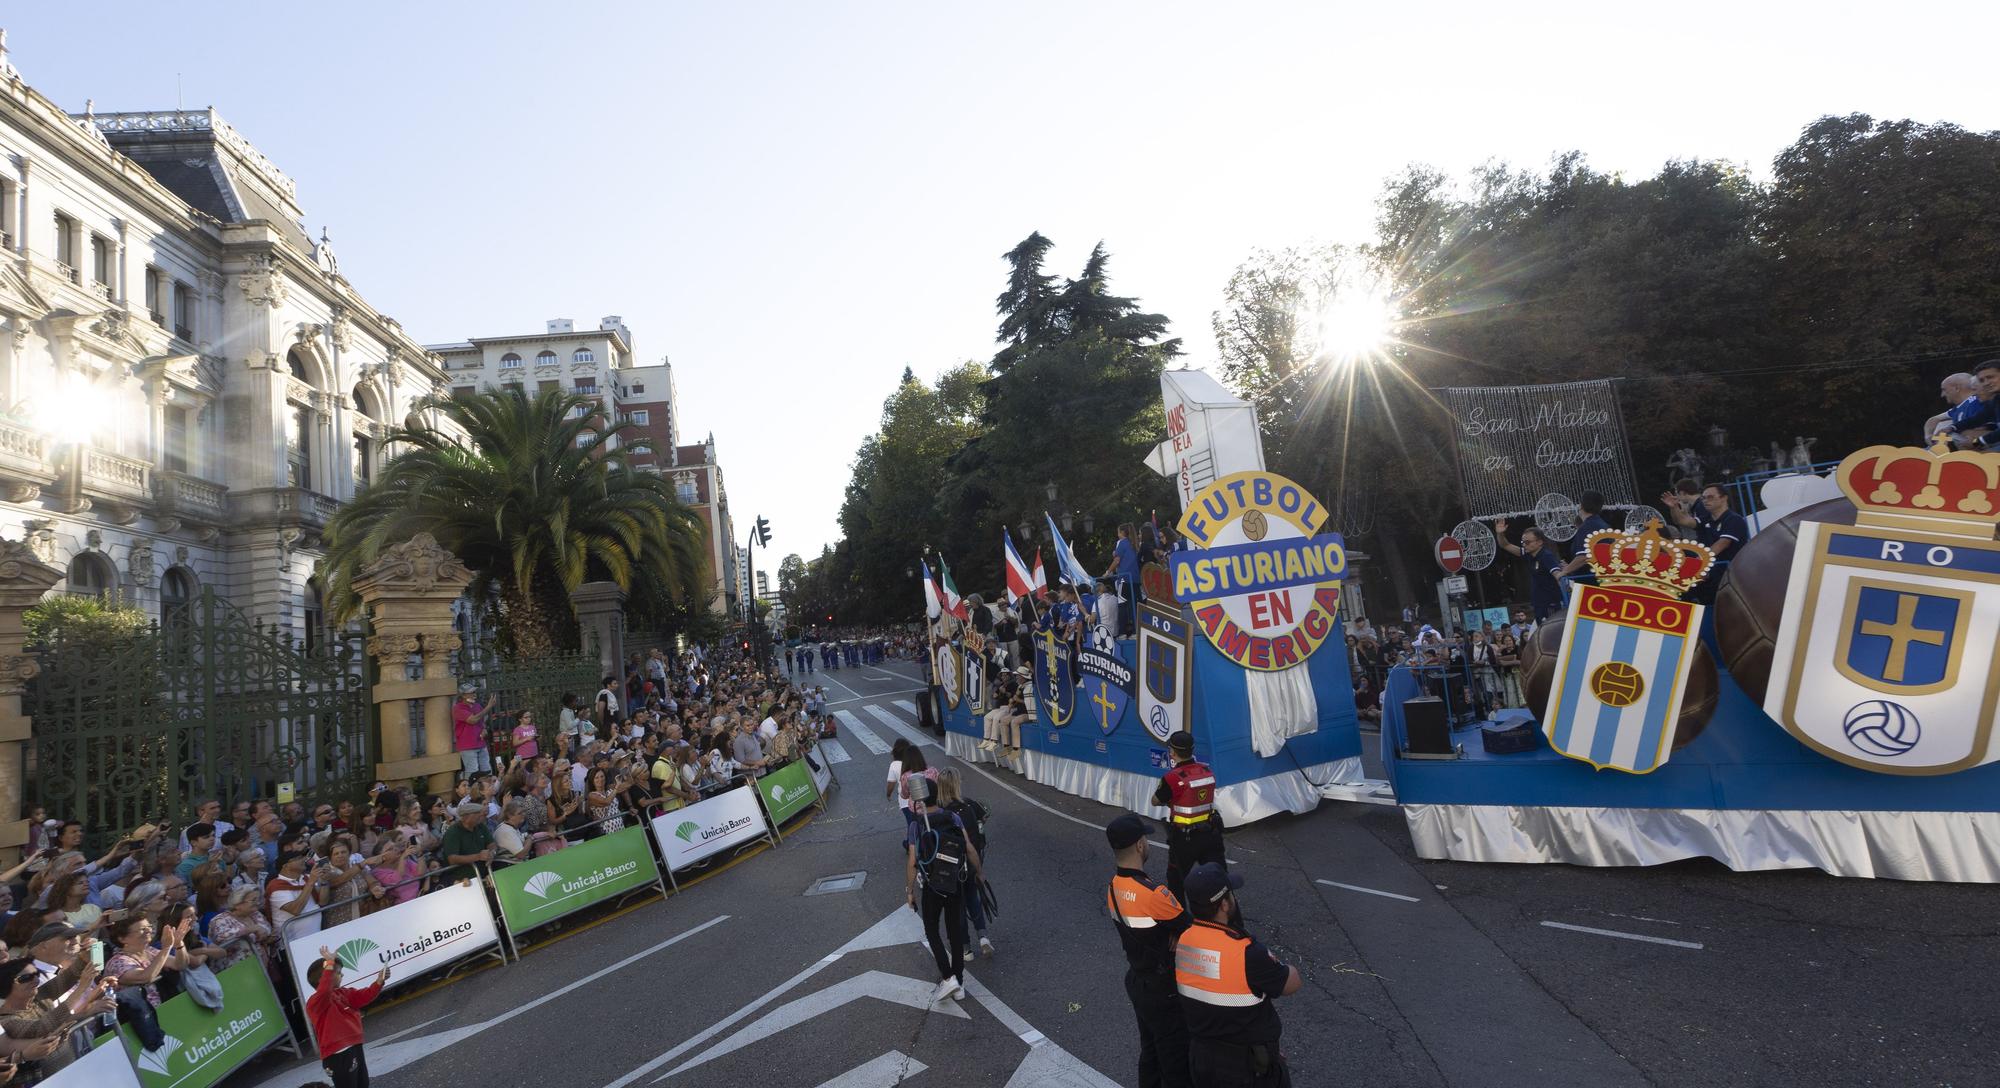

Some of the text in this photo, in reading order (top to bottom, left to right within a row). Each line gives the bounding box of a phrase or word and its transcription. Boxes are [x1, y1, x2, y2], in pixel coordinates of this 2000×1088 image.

[1463, 400, 1608, 435] San Mateo
[1173, 432, 1192, 454] DE LA
[1483, 433, 1612, 471] en Oviedo
[1187, 478, 1316, 542] FUTBOL
[1176, 543, 1346, 597] ASTURIANO
[1196, 588, 1339, 668] AMERICA
[1248, 590, 1294, 630] EN
[1587, 593, 1682, 629] C.D.O
[1037, 639, 1067, 661] ASTRIAS
[1077, 652, 1131, 682] ASTURIANO
[701, 816, 751, 840] Unicaja Banco
[562, 860, 637, 893] Unicaja Banco
[379, 921, 472, 963] Unicaja Banco
[184, 1009, 263, 1064] Unicaja Banco
